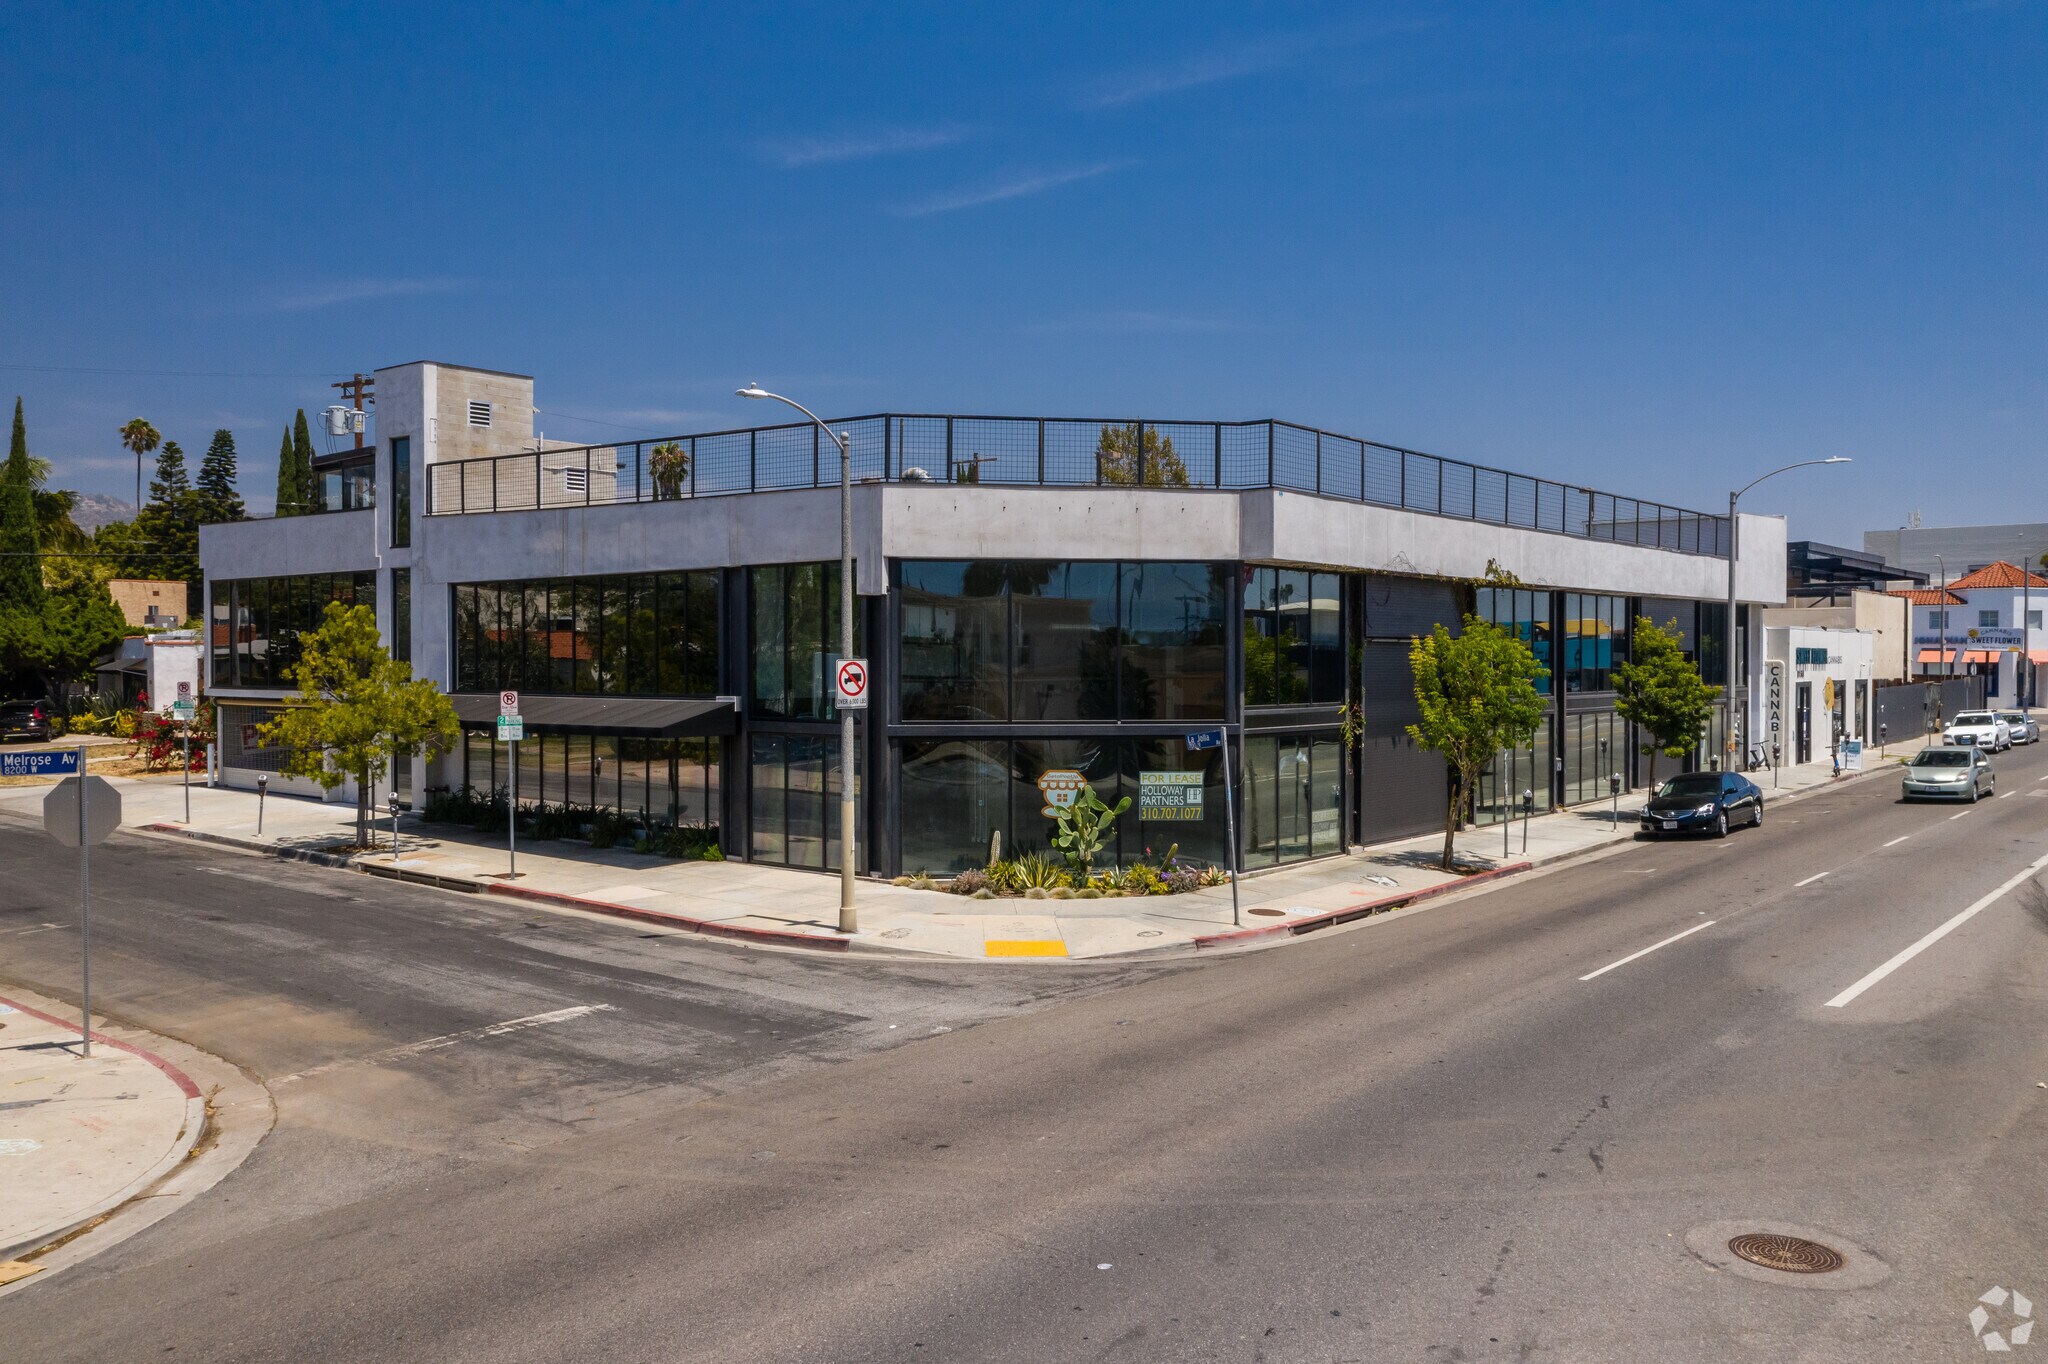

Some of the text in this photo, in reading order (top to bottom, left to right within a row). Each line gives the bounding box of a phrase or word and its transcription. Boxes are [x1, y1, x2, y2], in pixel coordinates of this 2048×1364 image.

[1972, 636, 1993, 644] SWEET
[1994, 636, 2021, 645] FLOWER
[1770, 666, 1780, 743] CANNABI
[4, 753, 75, 766] Melrose Av
[5, 766, 27, 774] 8200
[1142, 774, 1201, 783] FOR LEASE
[1141, 785, 1184, 795] HOLLOWAY
[1141, 796, 1184, 806] PARTNERS
[1142, 808, 1201, 819] 310.707.1077
